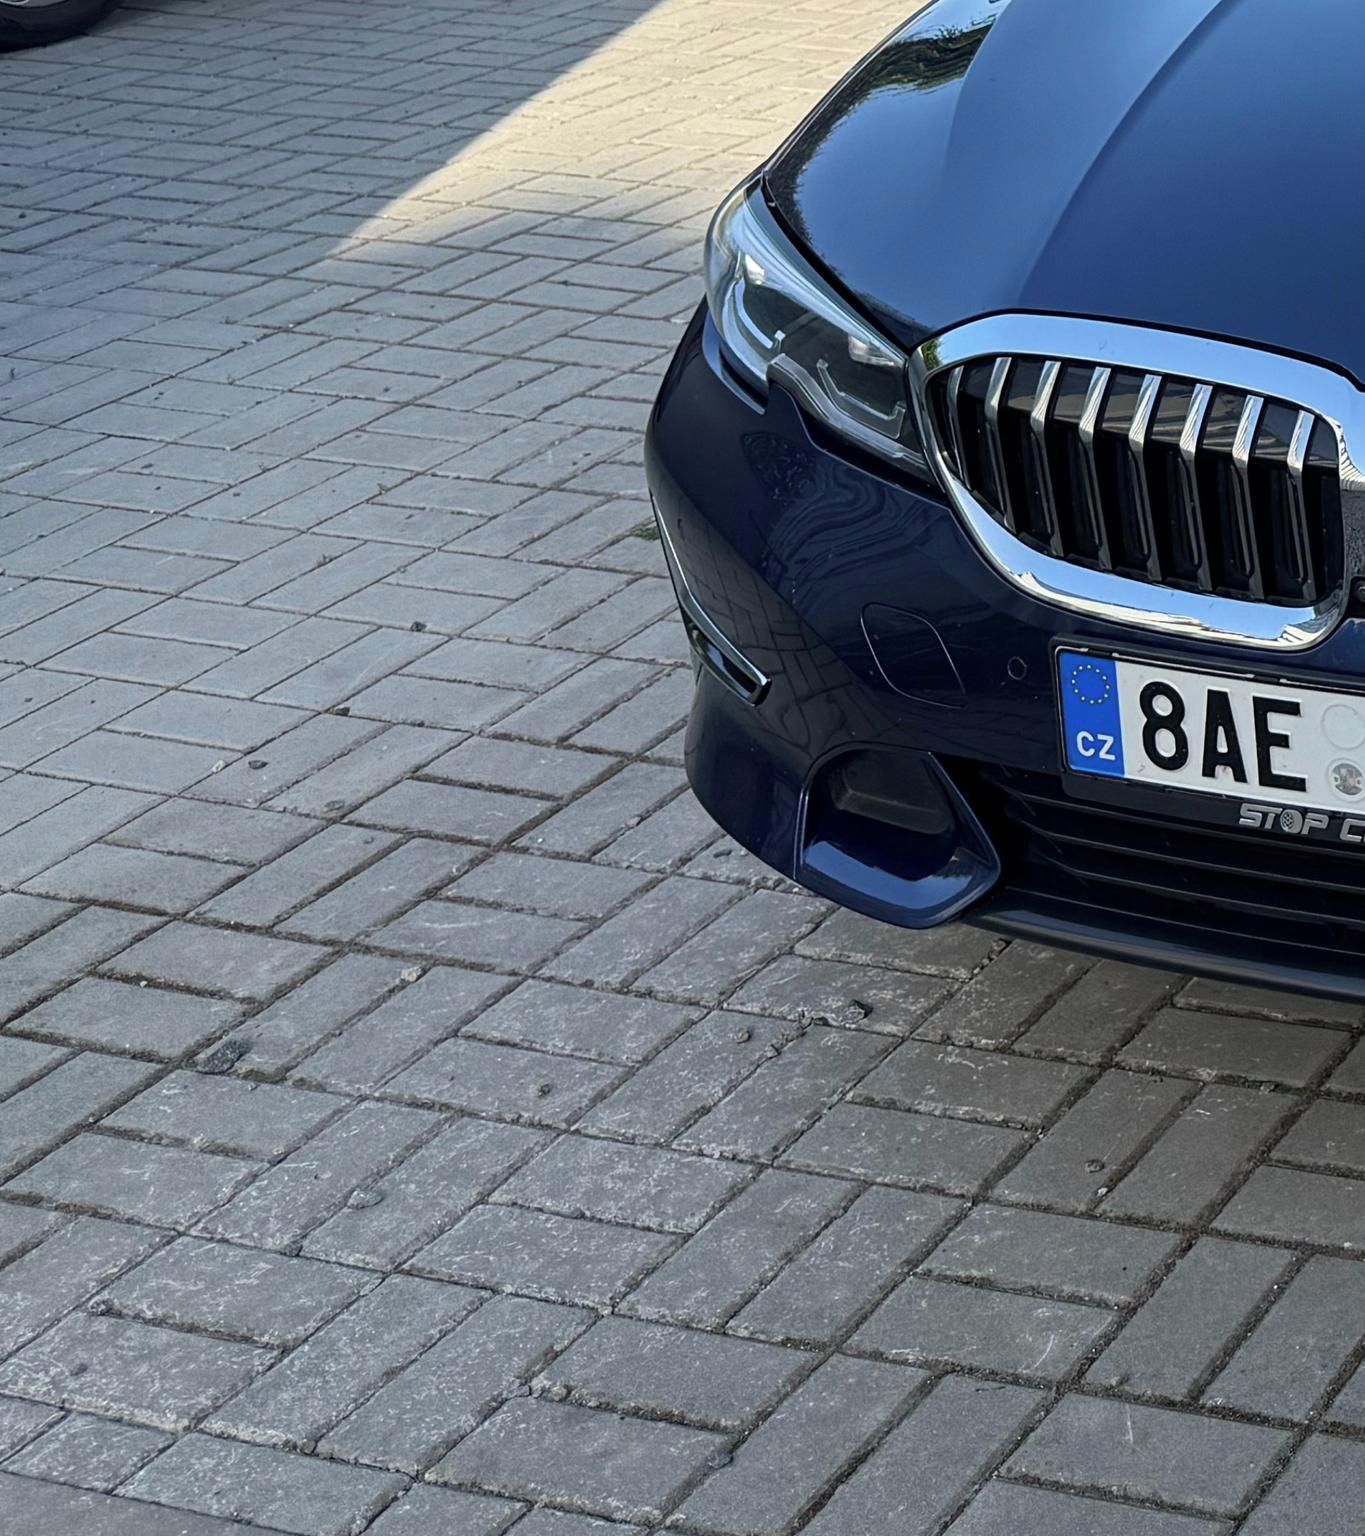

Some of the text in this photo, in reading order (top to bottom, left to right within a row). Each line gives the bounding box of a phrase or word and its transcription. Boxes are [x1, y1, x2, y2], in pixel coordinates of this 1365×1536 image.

[1076, 730, 1116, 761] CZ
[1139, 680, 1308, 793] 8AE
[1238, 802, 1330, 835] STOP
